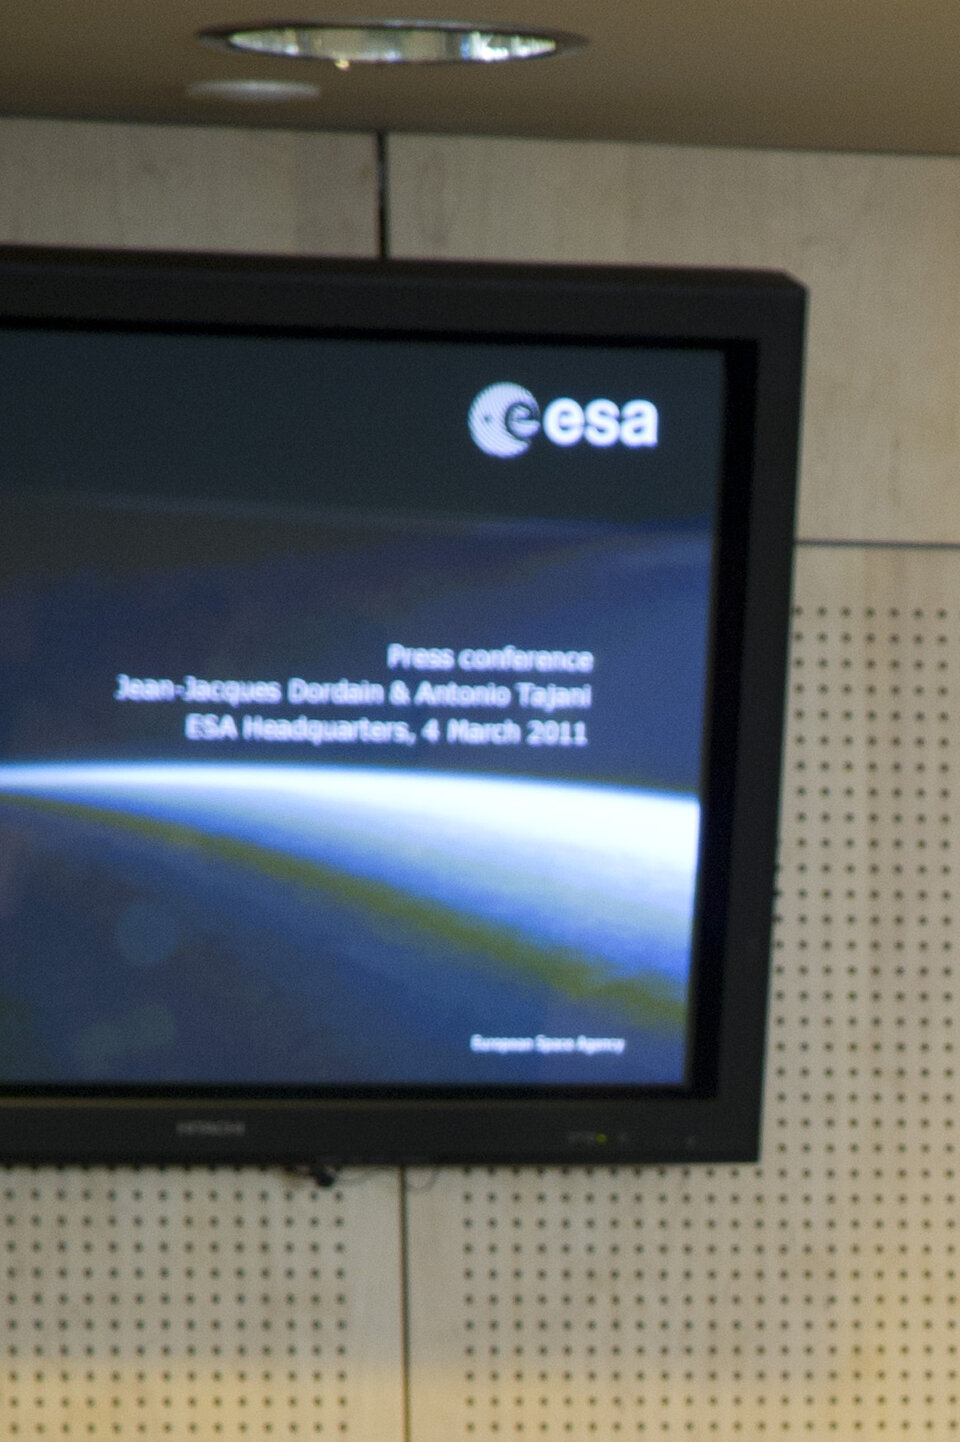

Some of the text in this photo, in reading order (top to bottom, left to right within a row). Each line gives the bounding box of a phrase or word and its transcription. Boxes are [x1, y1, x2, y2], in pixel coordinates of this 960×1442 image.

[543, 397, 659, 447] esa
[387, 643, 594, 673] Press conference
[114, 674, 592, 712] Jean-Jacques Dordain & Antonio Tajani
[185, 713, 589, 747] ESA Headquarters, 4 March 2011
[470, 1034, 625, 1055] European Space Agency
